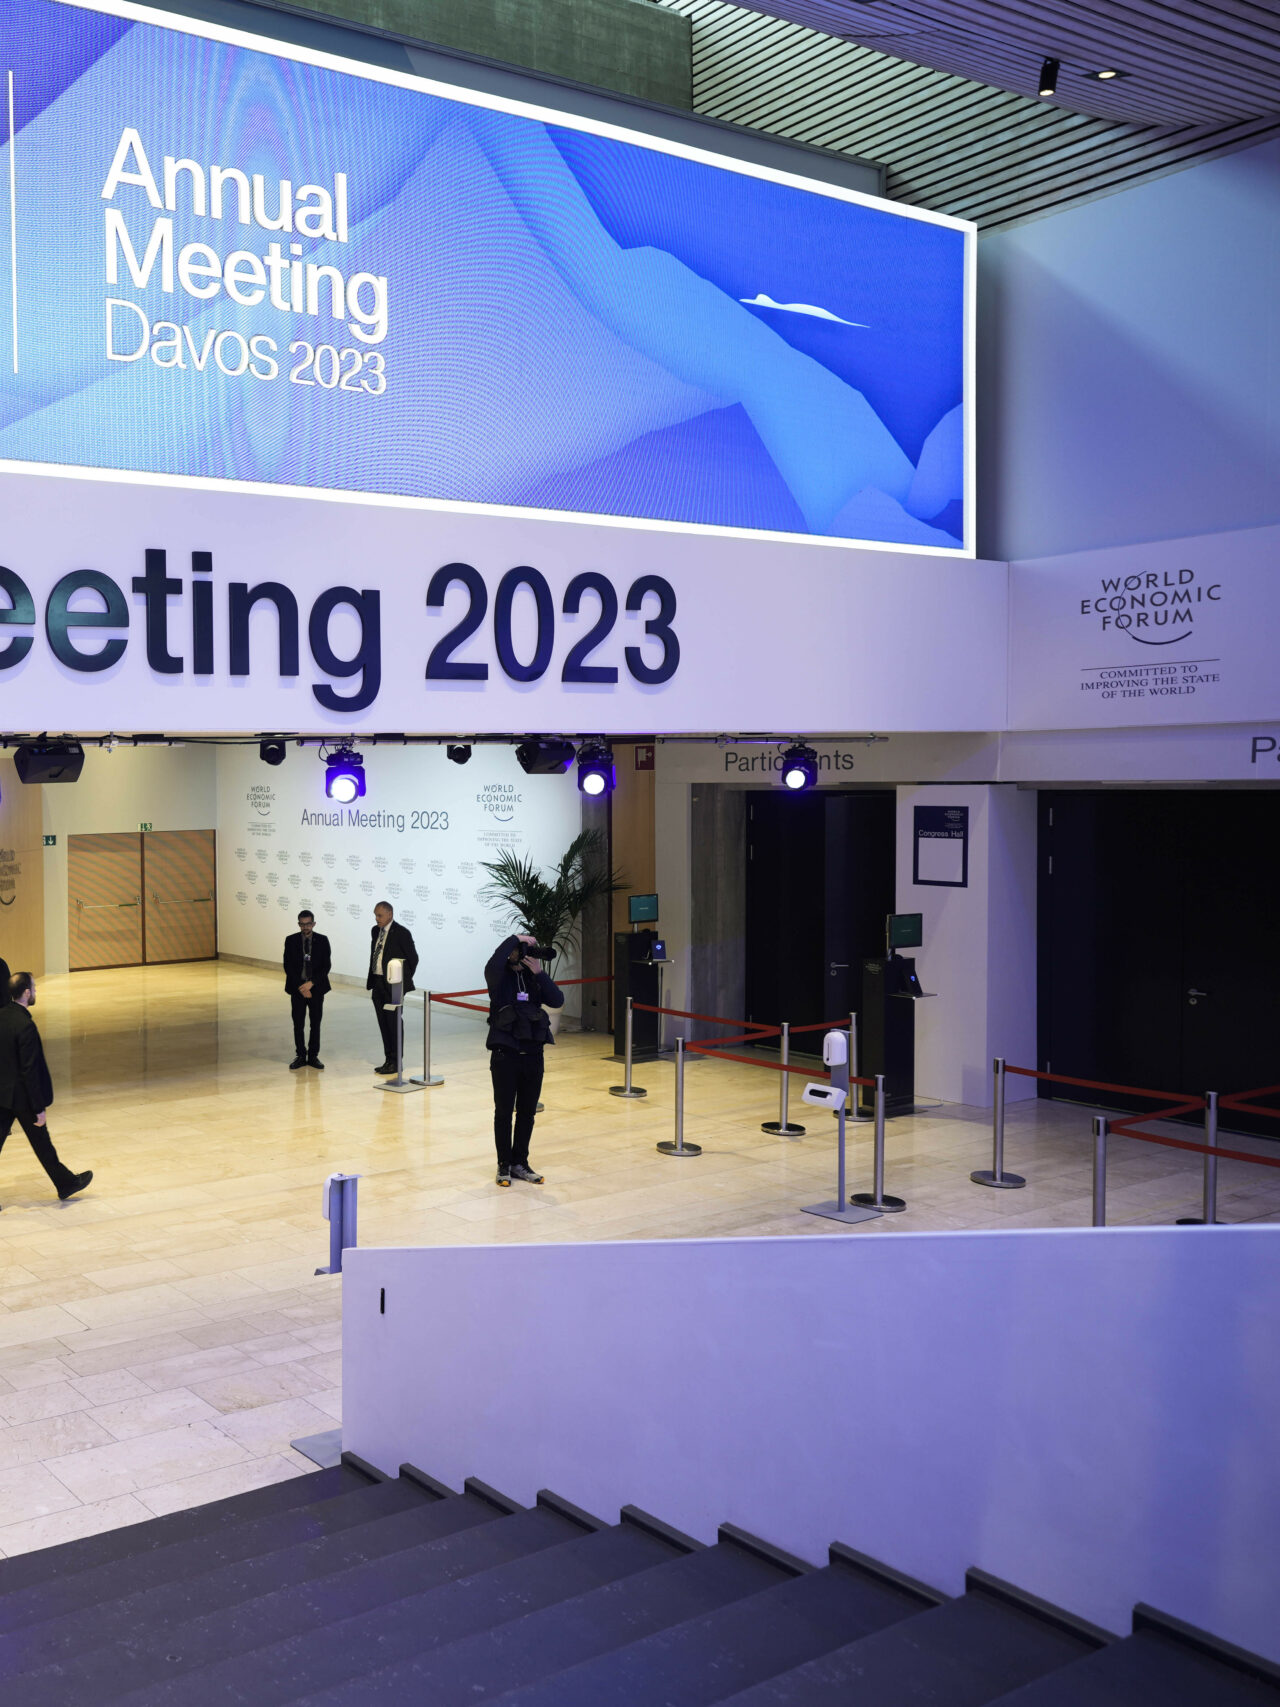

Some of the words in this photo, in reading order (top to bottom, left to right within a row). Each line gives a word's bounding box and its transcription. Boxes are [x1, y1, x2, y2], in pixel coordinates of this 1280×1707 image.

[100, 127, 349, 244] Annual
[104, 207, 388, 344] Meeting
[105, 297, 279, 380] Davos
[288, 340, 388, 396] 2023
[1101, 569, 1194, 593] WORLD
[1081, 584, 1221, 615] ECONOMIC
[424, 562, 681, 685] 2023
[1102, 607, 1194, 631] FORUM
[1080, 678, 1149, 691] IMPROVING
[1152, 677, 1178, 686] THE
[1182, 673, 1221, 684] STATE
[1099, 666, 1177, 680] COMMITTED
[1181, 664, 1198, 674] TO
[1101, 691, 1117, 699] OF
[1120, 688, 1145, 698] THE
[1149, 685, 1196, 697] WORLD
[725, 750, 854, 772] Particnts
[1251, 736, 1280, 763] P
[476, 794, 522, 803] ECONOMIC
[483, 784, 514, 793] WORLD
[483, 803, 514, 812] FORUM
[301, 808, 344, 827] Annual
[348, 809, 405, 833] Meeting
[411, 810, 449, 830] 2023
[918, 829, 949, 838] Congress
[950, 830, 964, 838] Hall
